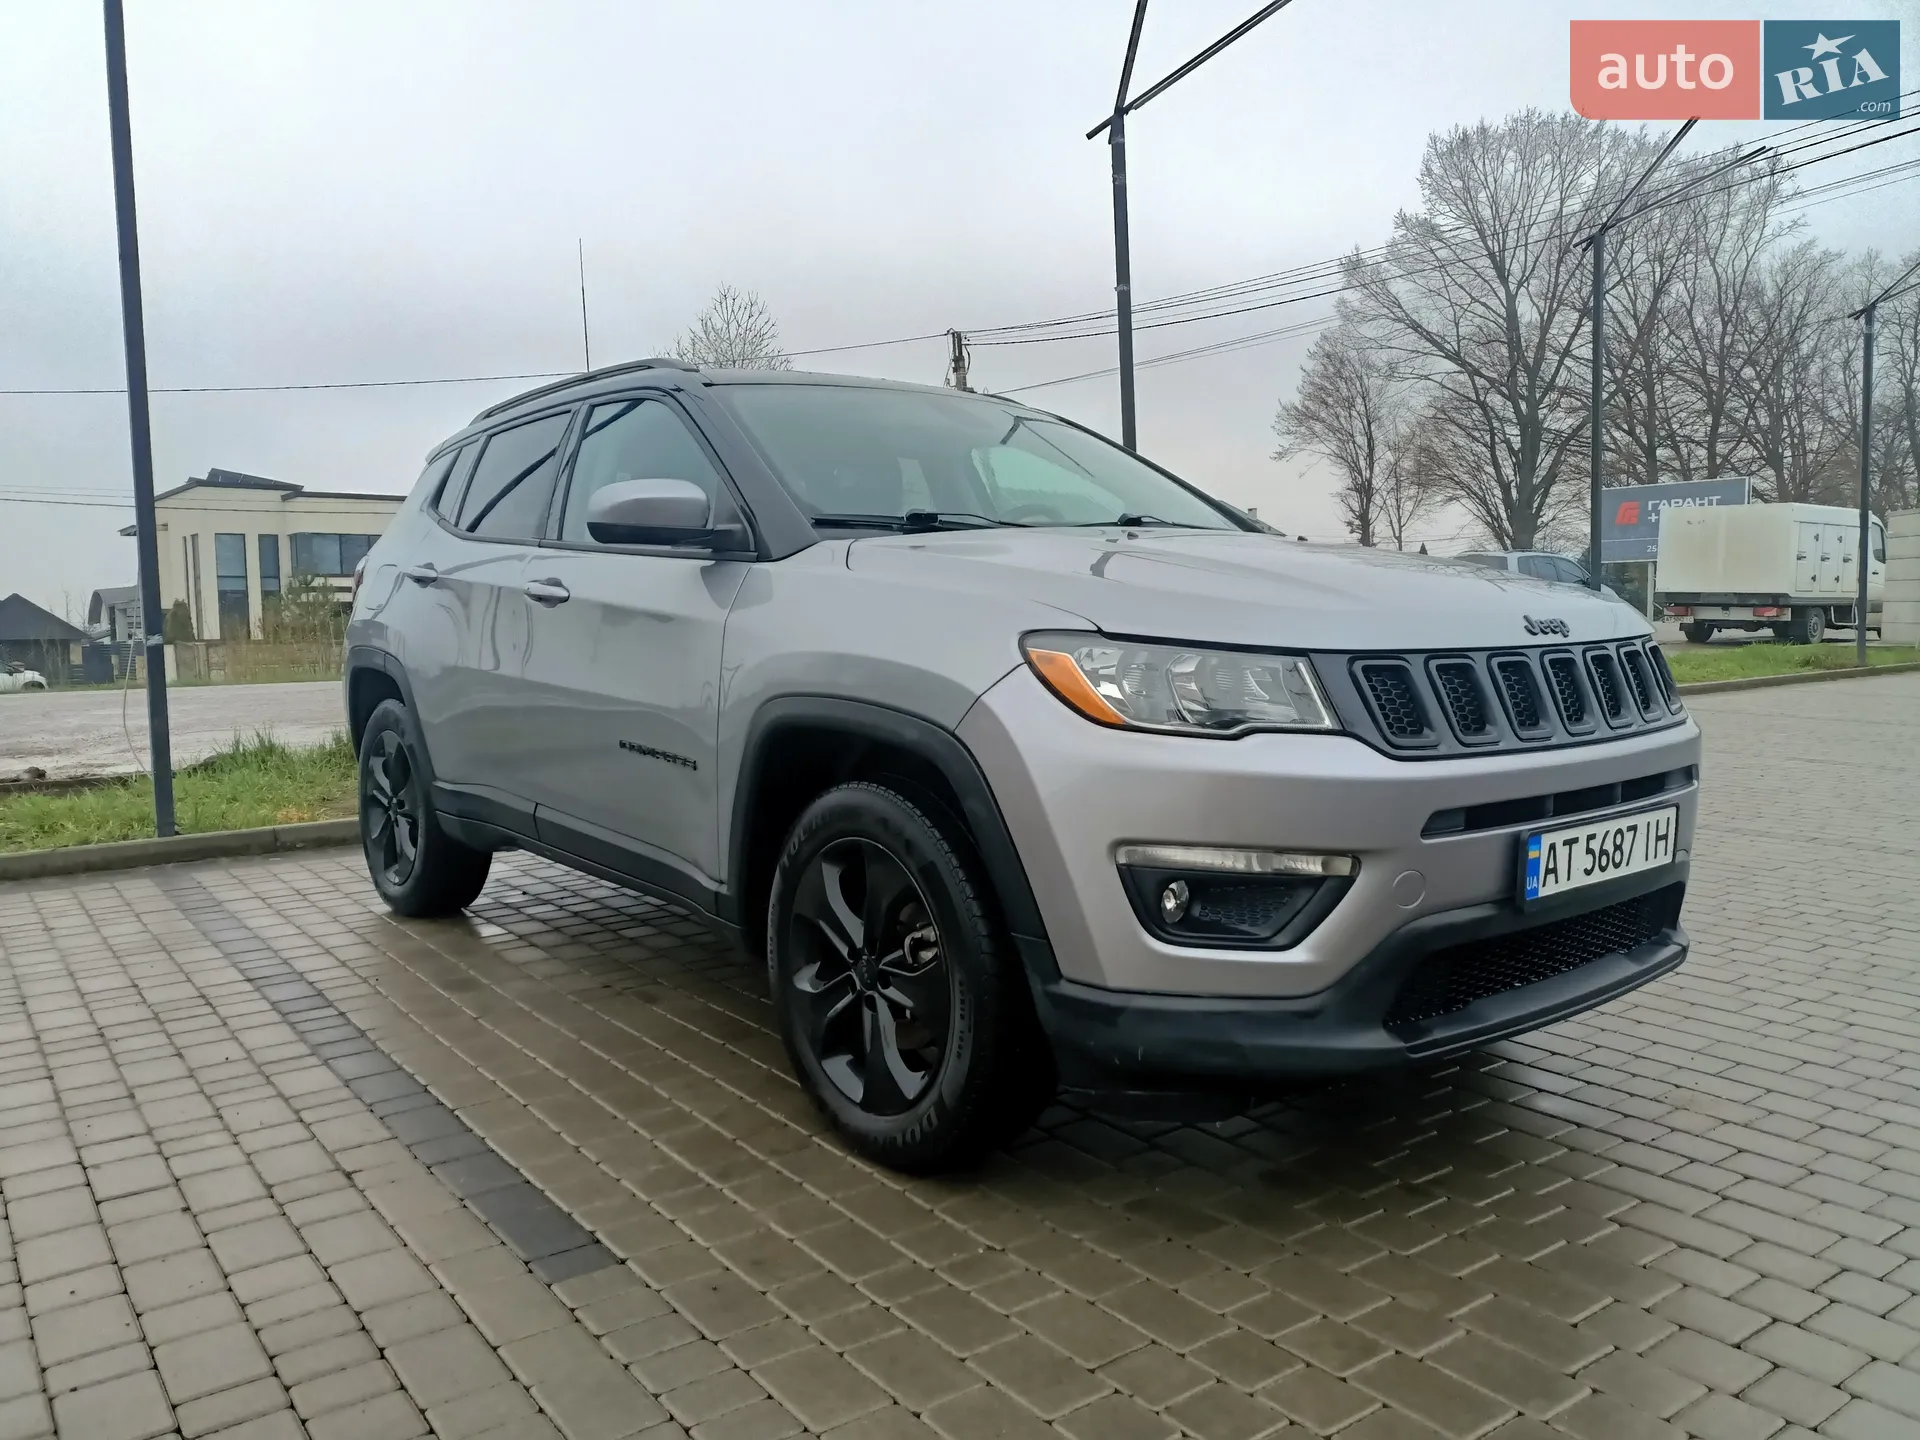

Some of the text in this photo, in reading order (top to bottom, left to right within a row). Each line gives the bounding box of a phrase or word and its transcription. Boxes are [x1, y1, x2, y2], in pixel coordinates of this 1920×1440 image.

[1648, 496, 1721, 510] ГАРАНТ
[1523, 614, 1570, 638] Jeep
[1542, 816, 1671, 888] AT 5687 IH
[1526, 875, 1538, 890] UA
